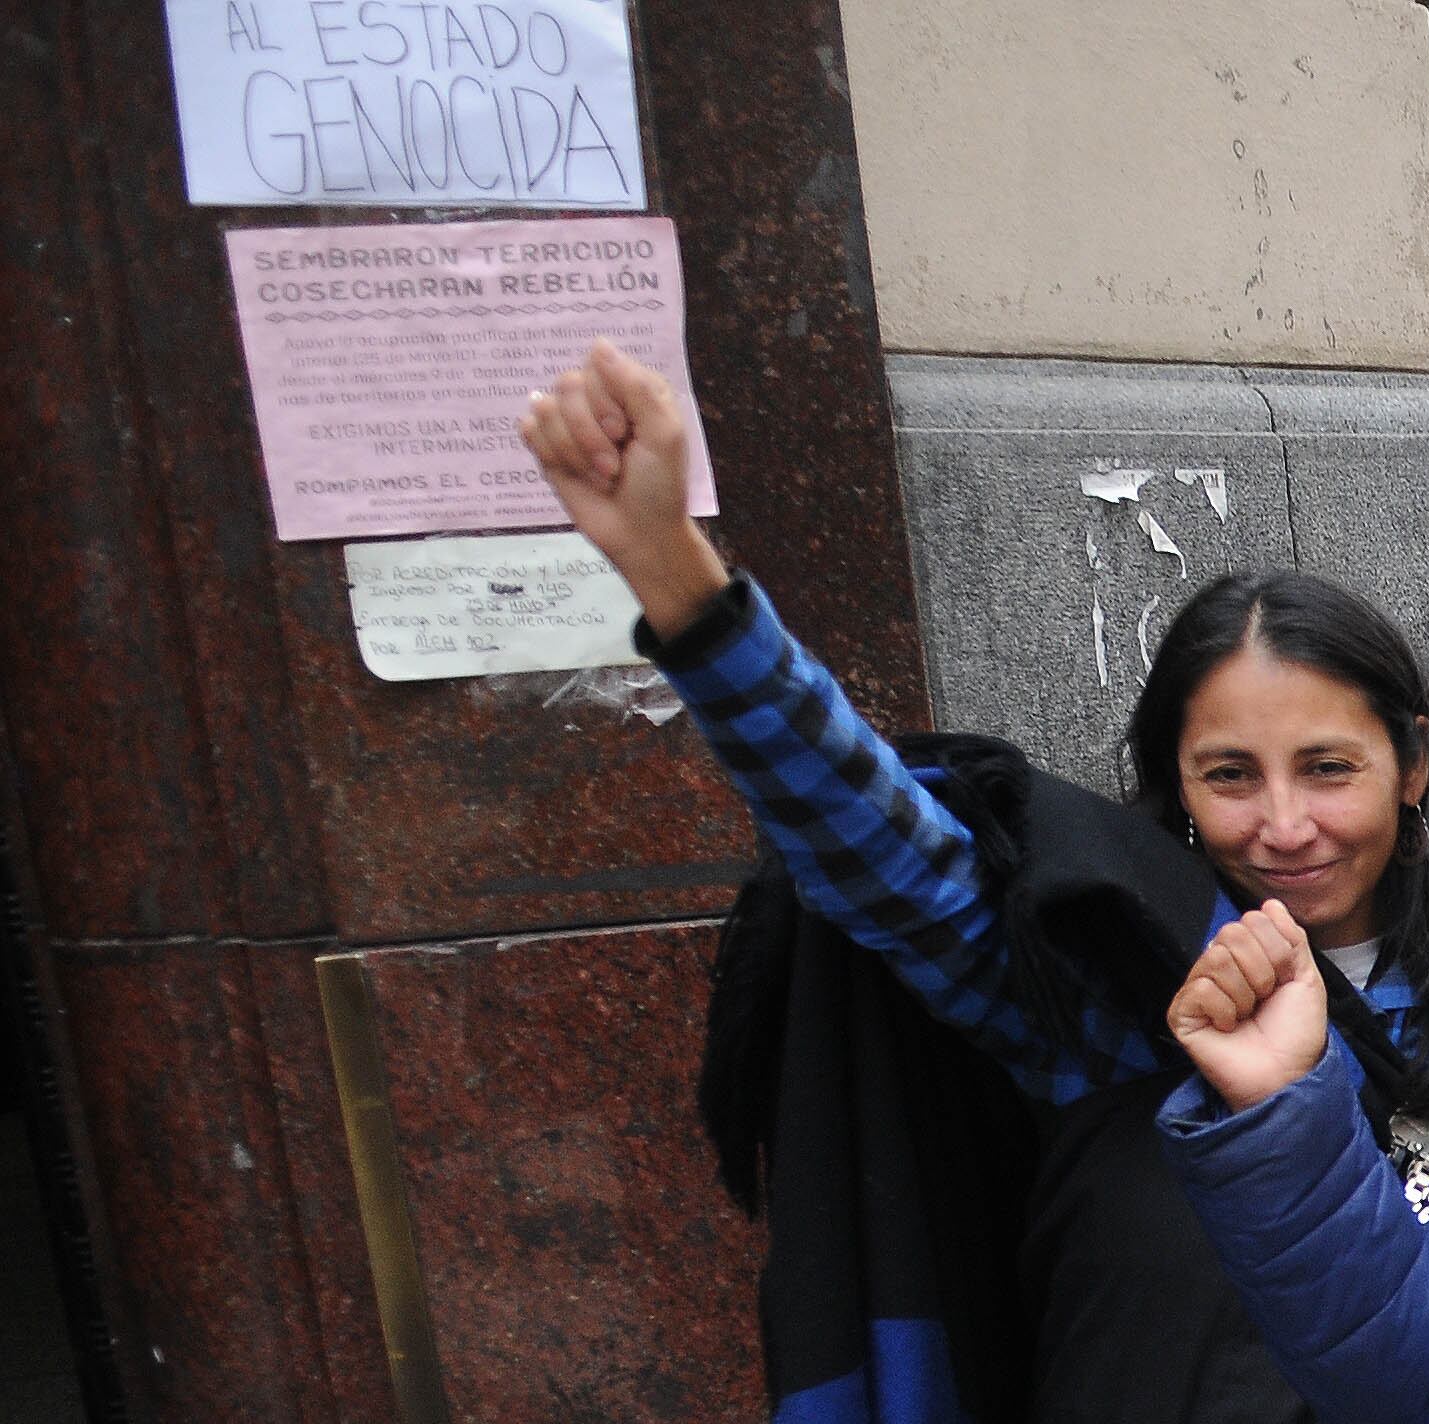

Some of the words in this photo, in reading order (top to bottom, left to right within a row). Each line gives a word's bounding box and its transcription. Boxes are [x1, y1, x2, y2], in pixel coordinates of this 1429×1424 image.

[226, 2, 282, 52] AL
[310, 1, 567, 76] ESTADO
[244, 70, 629, 200] GENOCIDA
[254, 247, 460, 271] SEMBRARON
[476, 239, 654, 264] TERRICIDIO
[258, 277, 483, 303] COSECHARAN
[500, 264, 659, 295] REBELIÓN
[308, 421, 411, 441] EXIGIMOS
[418, 417, 461, 437] UNA
[294, 475, 429, 496] ROMPAMOS
[440, 473, 467, 488] EL
